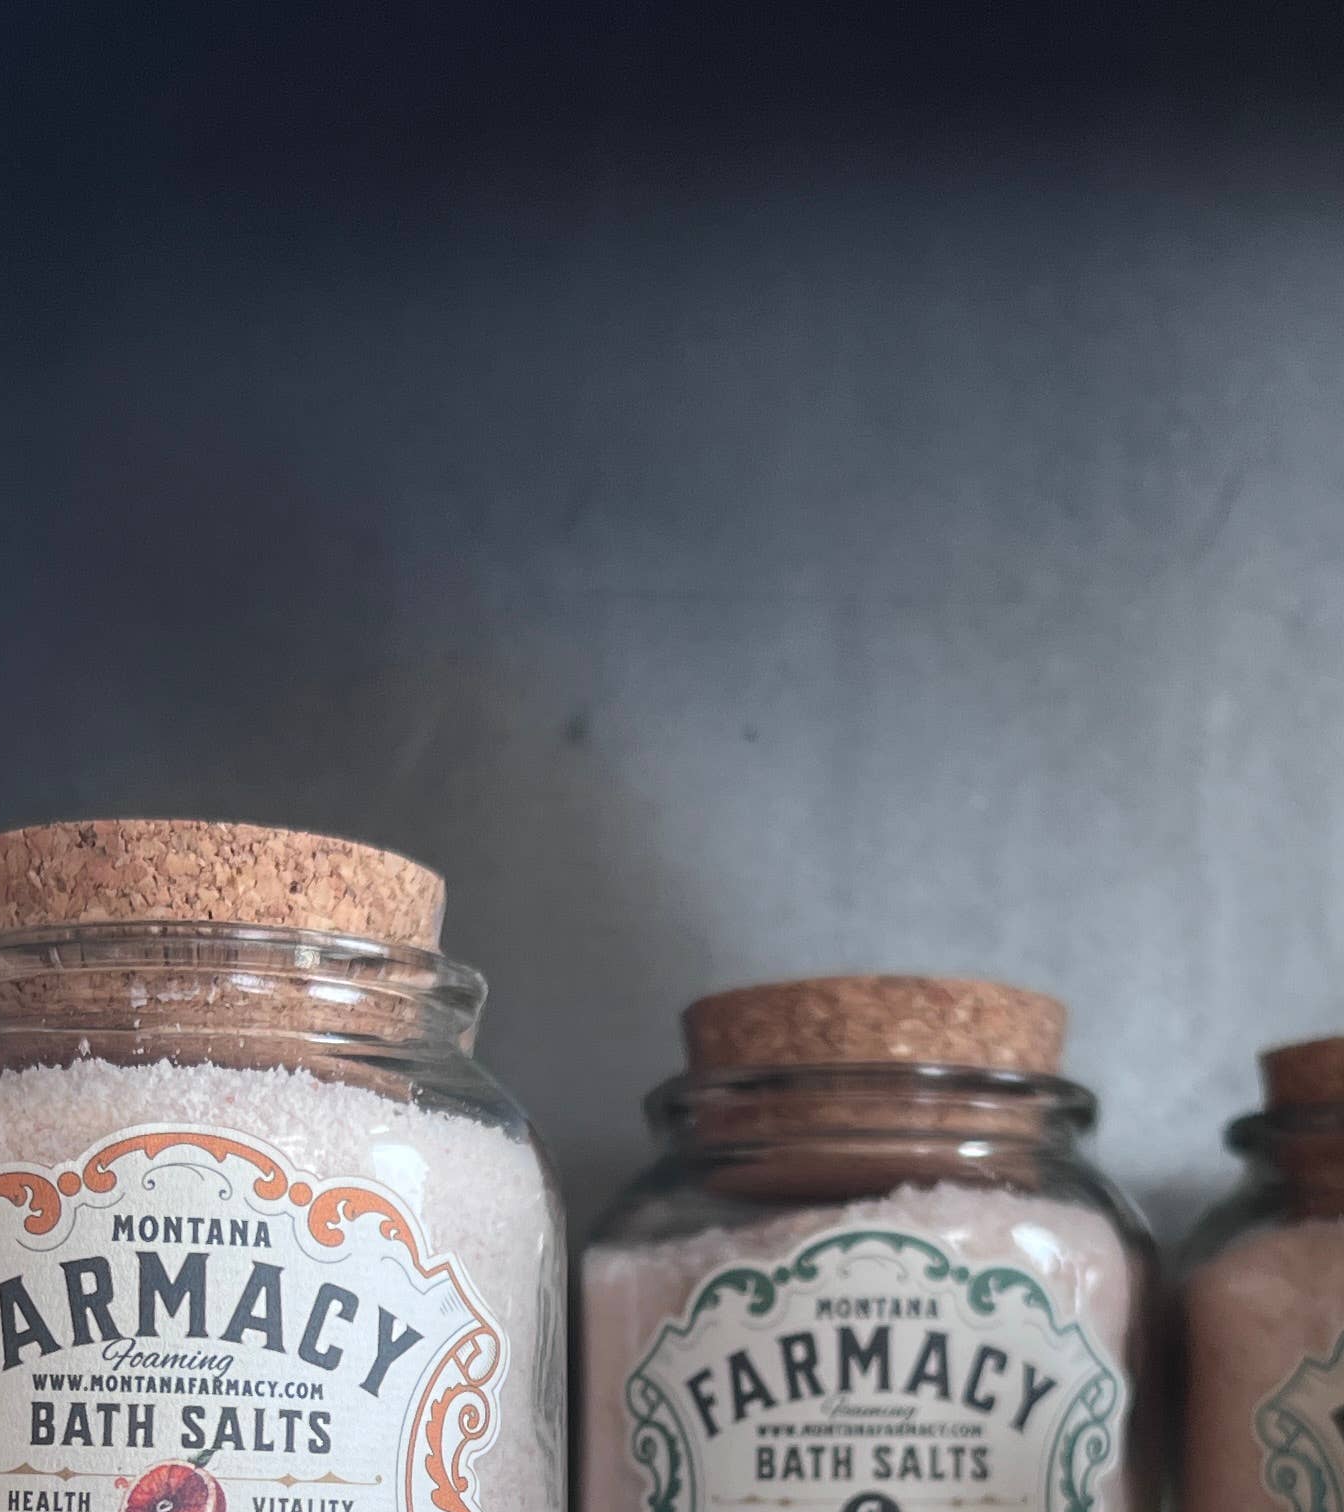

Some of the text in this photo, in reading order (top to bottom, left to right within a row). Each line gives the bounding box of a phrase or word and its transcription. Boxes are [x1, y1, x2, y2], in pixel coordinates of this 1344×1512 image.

[112, 1214, 271, 1248] MONTANA
[815, 1296, 939, 1321] MONTANA
[102, 1338, 233, 1378] Foaming
[33, 1373, 323, 1400] WWW.MONTANAFARMACY.COM
[685, 1325, 1059, 1439] FARMACY
[31, 1401, 331, 1454] BATH SALTS
[758, 1446, 991, 1480] BATH SALTS
[8, 1490, 91, 1512] HEALTH
